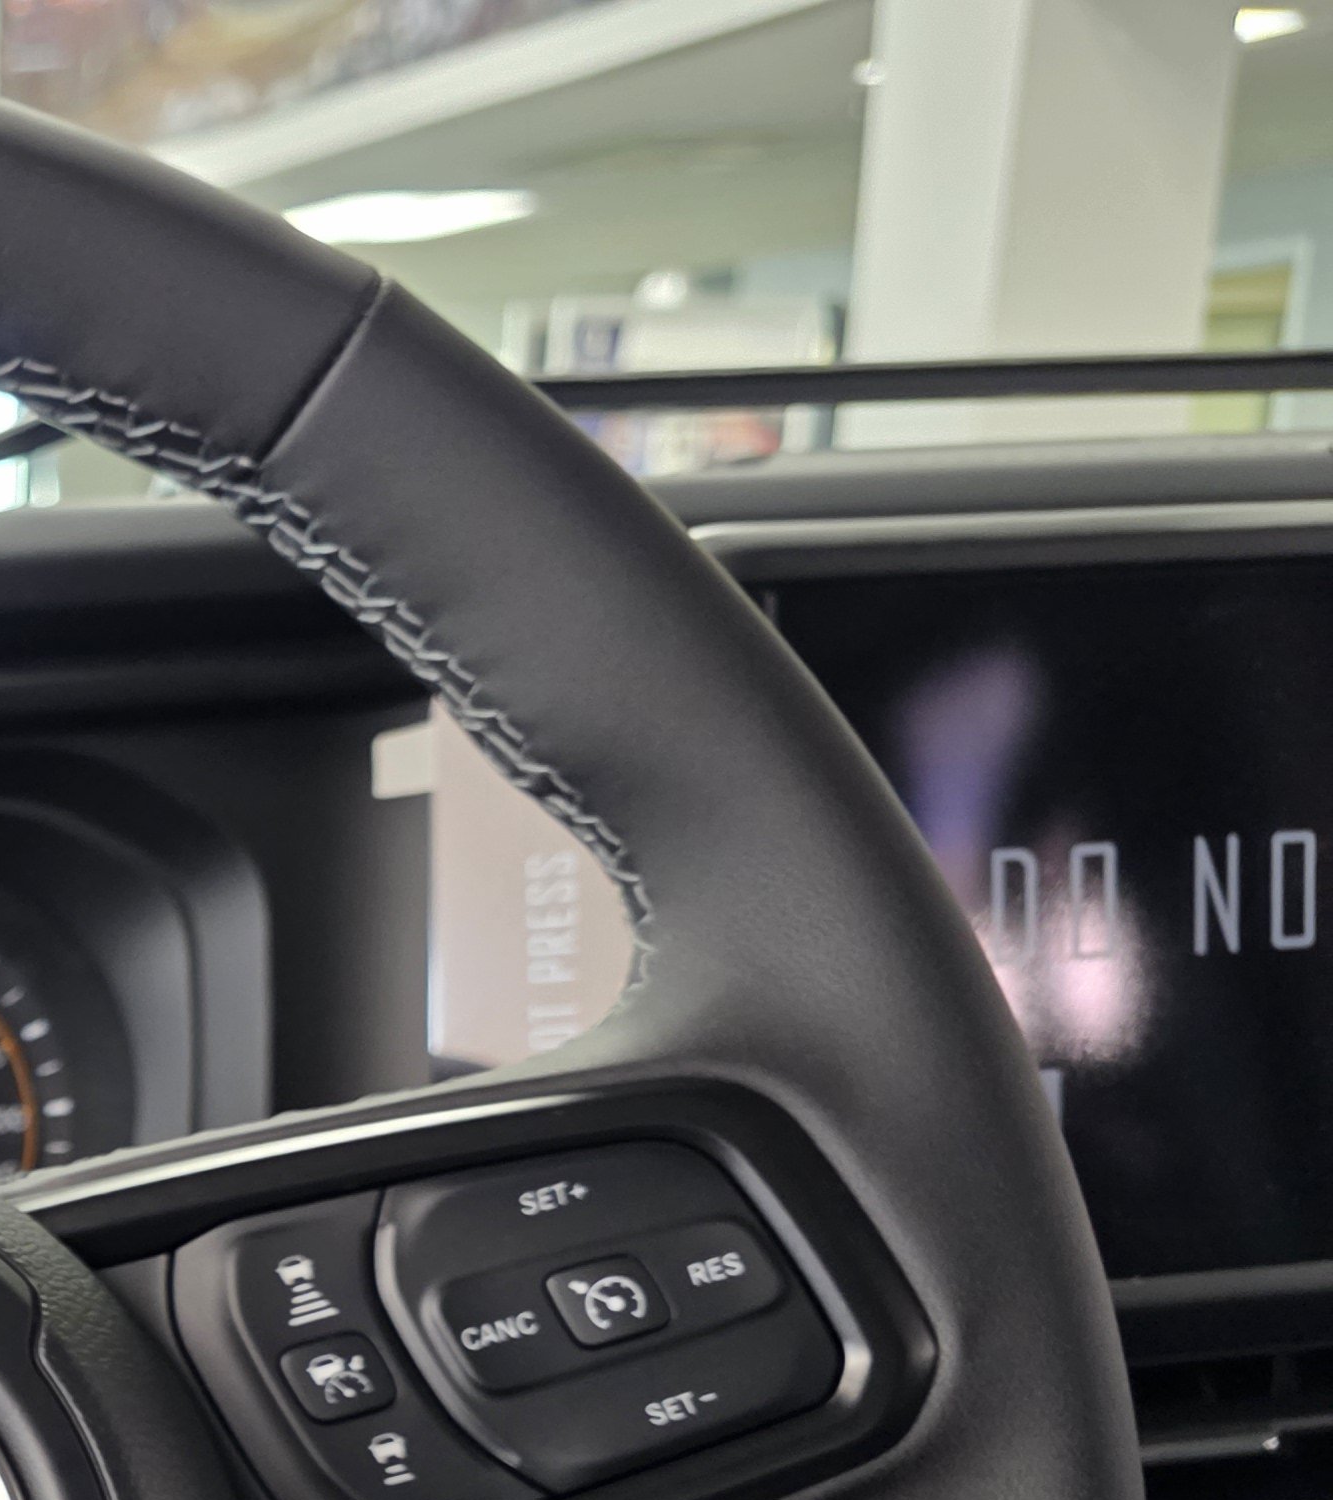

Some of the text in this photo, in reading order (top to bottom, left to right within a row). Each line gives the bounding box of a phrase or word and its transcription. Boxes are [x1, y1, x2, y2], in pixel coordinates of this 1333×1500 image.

[524, 851, 579, 984] PRESS
[991, 830, 1317, 962] DO NO
[686, 1251, 746, 1286] RES
[460, 1311, 540, 1351] CANC
